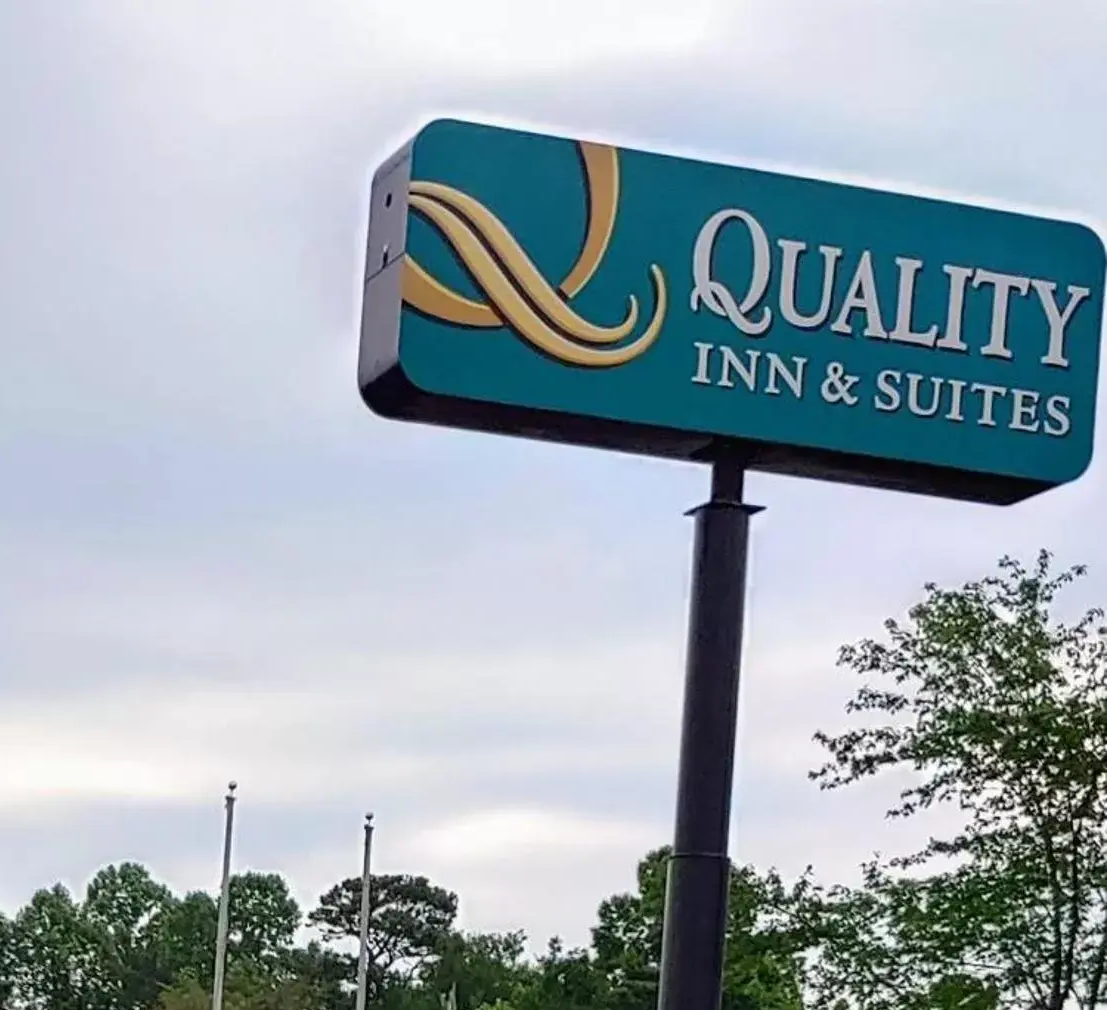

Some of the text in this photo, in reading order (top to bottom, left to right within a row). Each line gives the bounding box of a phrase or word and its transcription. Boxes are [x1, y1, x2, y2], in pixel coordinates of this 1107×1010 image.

[690, 208, 1090, 368] QUALITY
[691, 342, 1070, 436] INN & SUITES
